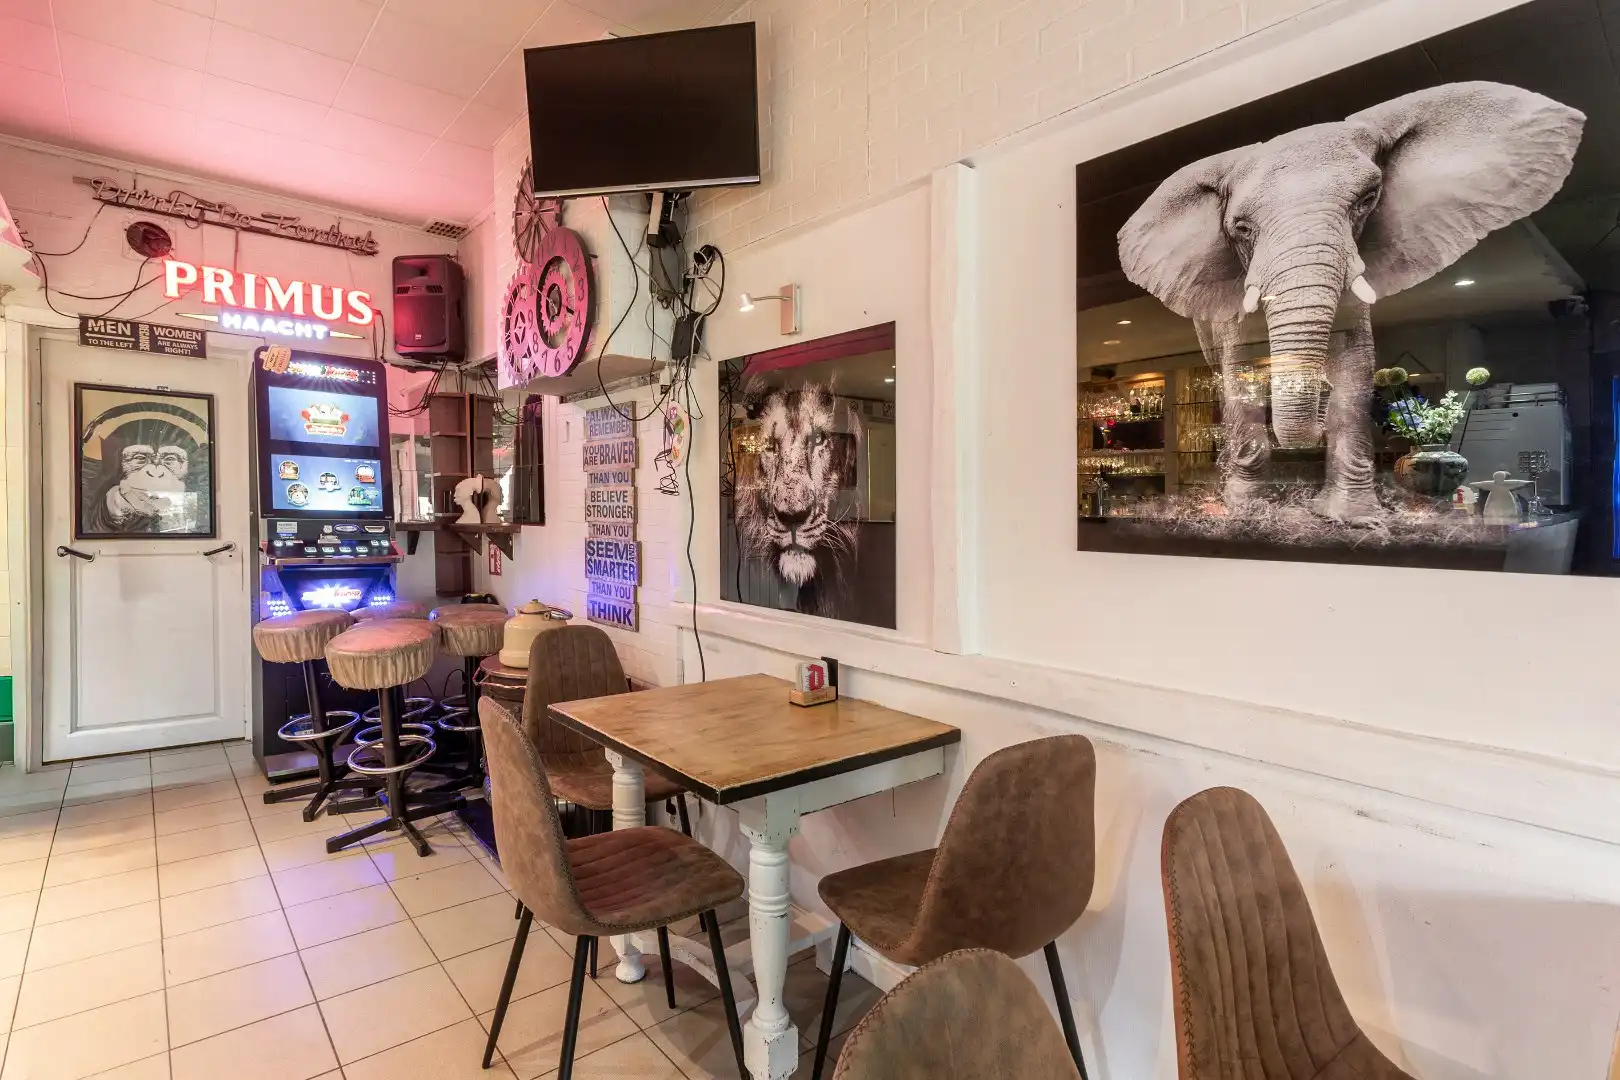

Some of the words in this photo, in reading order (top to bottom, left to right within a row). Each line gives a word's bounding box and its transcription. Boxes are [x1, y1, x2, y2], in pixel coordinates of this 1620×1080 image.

[163, 259, 375, 325] PRIMUS
[578, 277, 585, 302] 3
[87, 318, 131, 336] MEN
[221, 312, 330, 339] HAACHT
[527, 309, 534, 330] 9
[575, 310, 583, 333] 4
[138, 323, 151, 351] BECAUSE
[152, 326, 202, 341] WOMEN
[532, 332, 539, 354] 8
[115, 341, 133, 349] LEFT
[165, 346, 192, 355] RIGHT!
[172, 342, 198, 350] ALWAYS
[566, 337, 574, 360] 5
[554, 350, 561, 373] 6
[588, 404, 631, 424] ALWAYS
[589, 419, 632, 437] REMEMBER
[584, 445, 600, 457] YOU
[584, 456, 598, 467] ARE
[600, 441, 635, 465] BRAVER
[589, 472, 610, 484] THAN
[612, 471, 629, 483] YOU
[590, 490, 629, 504] BELIEVE
[586, 504, 633, 519] STRONGER
[592, 524, 611, 537] THAN
[613, 525, 629, 538] YOU
[587, 540, 629, 561] SEEM
[587, 558, 636, 582] SMARTER
[592, 581, 612, 596] THAN
[614, 585, 632, 600] YOU
[590, 600, 633, 627] THINK
